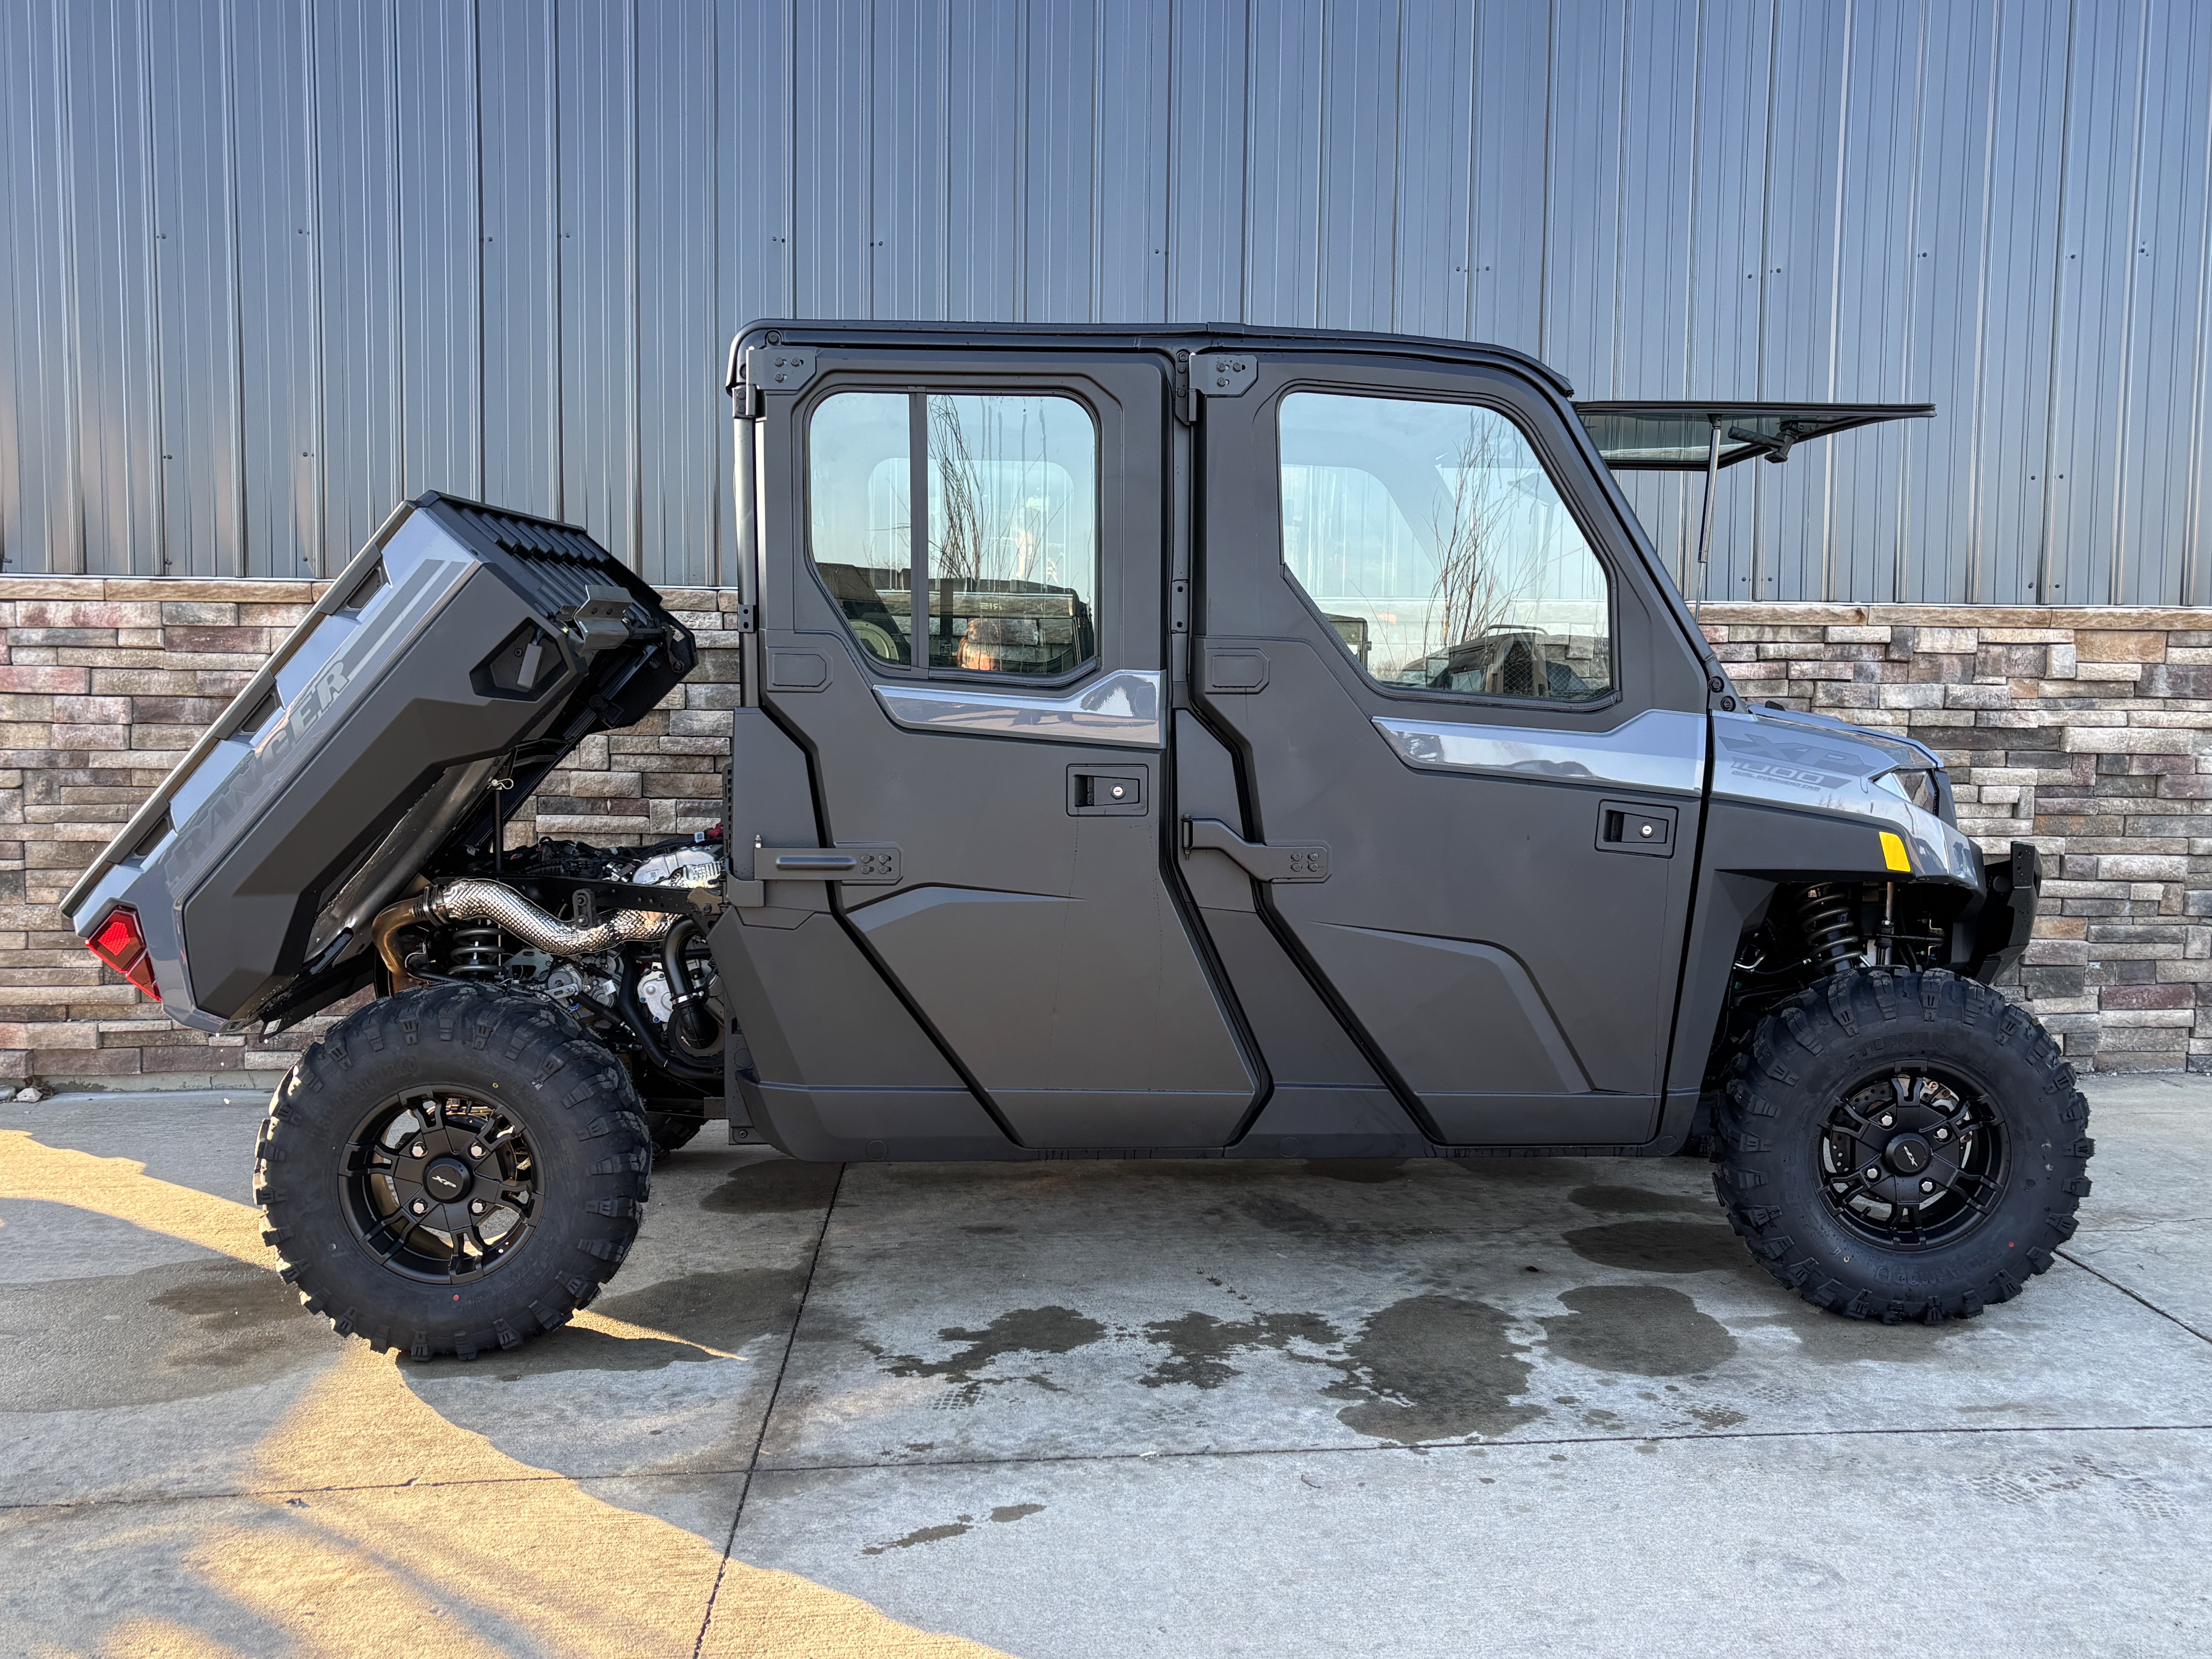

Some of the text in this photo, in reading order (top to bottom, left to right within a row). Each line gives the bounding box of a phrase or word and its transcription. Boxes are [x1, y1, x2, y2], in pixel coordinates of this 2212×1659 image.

[1721, 733, 1870, 773] XP
[164, 659, 351, 883] RANGER
[1731, 770, 1755, 779] DUAL
[1755, 775, 1801, 787] OVERHEAD
[1732, 760, 1825, 784] 1000
[1903, 1146, 1918, 1167] XP
[432, 1175, 457, 1188] XP
